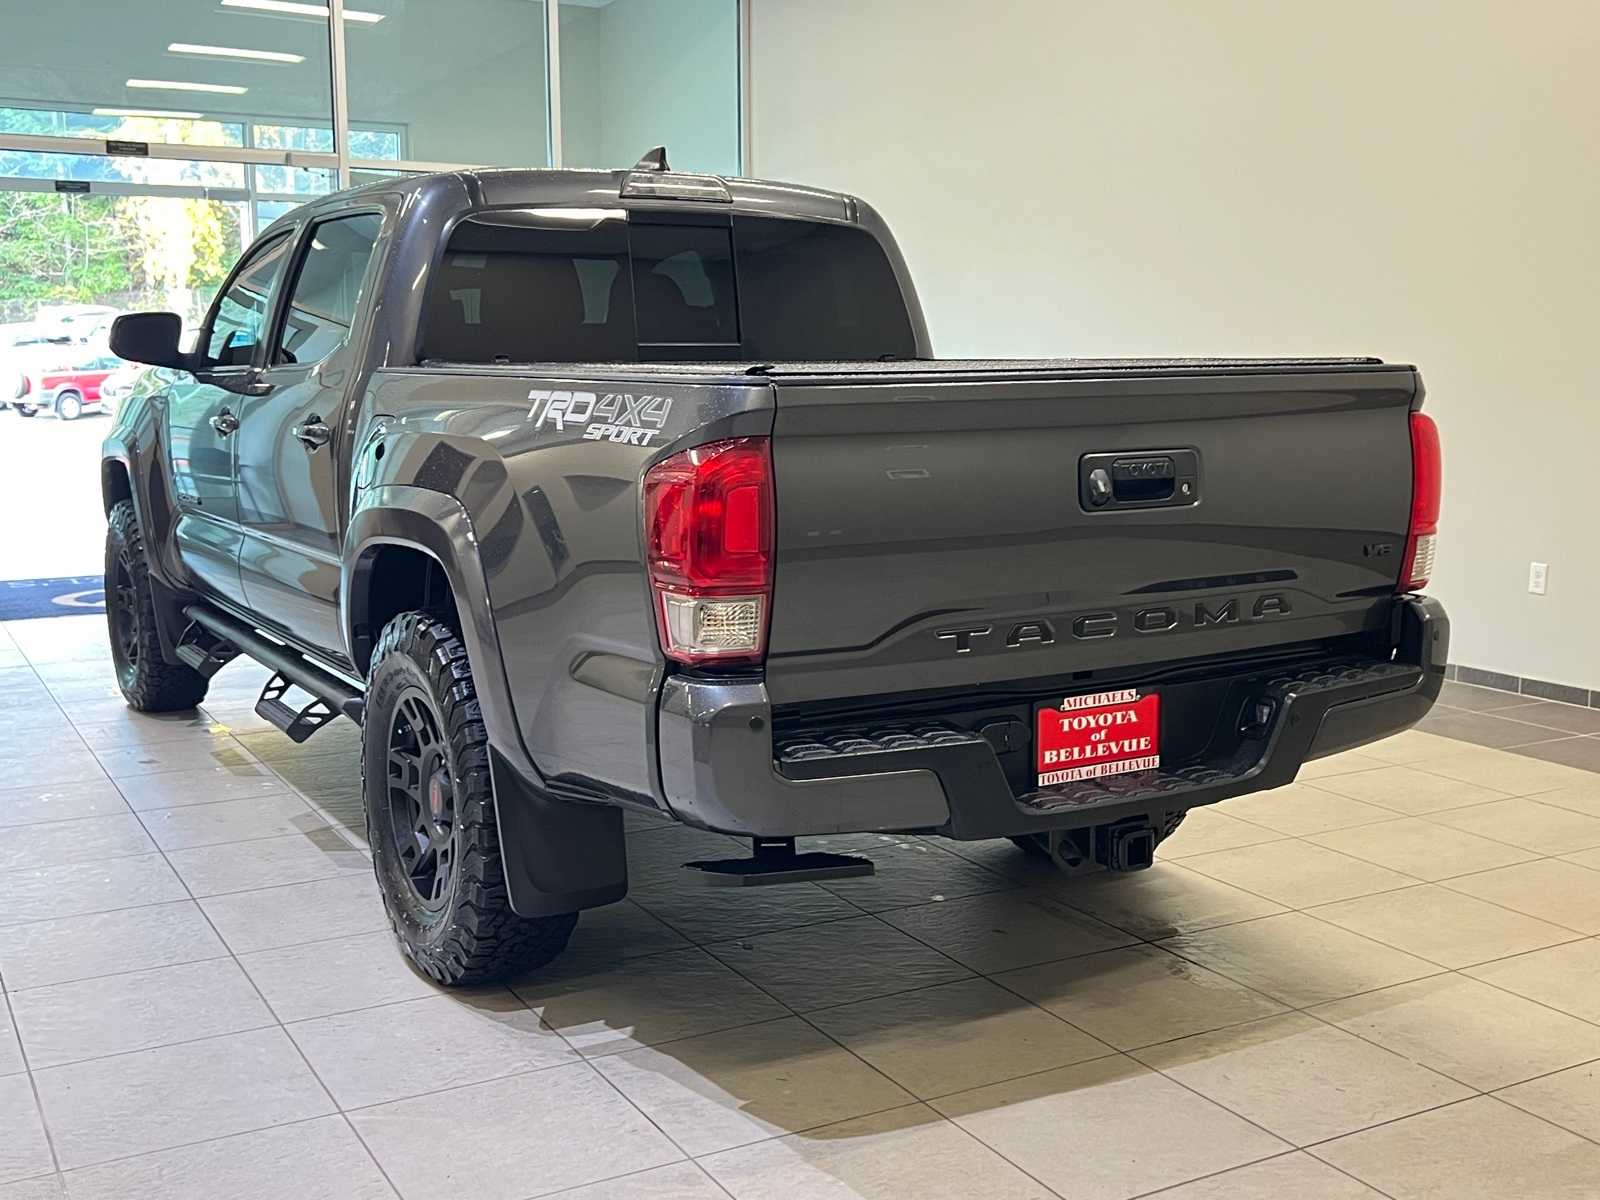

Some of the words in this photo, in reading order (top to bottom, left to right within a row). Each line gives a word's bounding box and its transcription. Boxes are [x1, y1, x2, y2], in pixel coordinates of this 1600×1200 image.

[527, 390, 596, 430] TRD
[583, 423, 660, 446] SPORT
[935, 594, 1291, 652] TACOMA
[1065, 689, 1135, 709] MICHAELS
[1059, 710, 1139, 732] TOYOTA
[1090, 729, 1108, 741] of
[1043, 736, 1151, 764] BELLEVUE
[1040, 768, 1083, 786] TOYOTA
[1086, 766, 1097, 778] of
[1100, 756, 1158, 775] BELLEVUE
